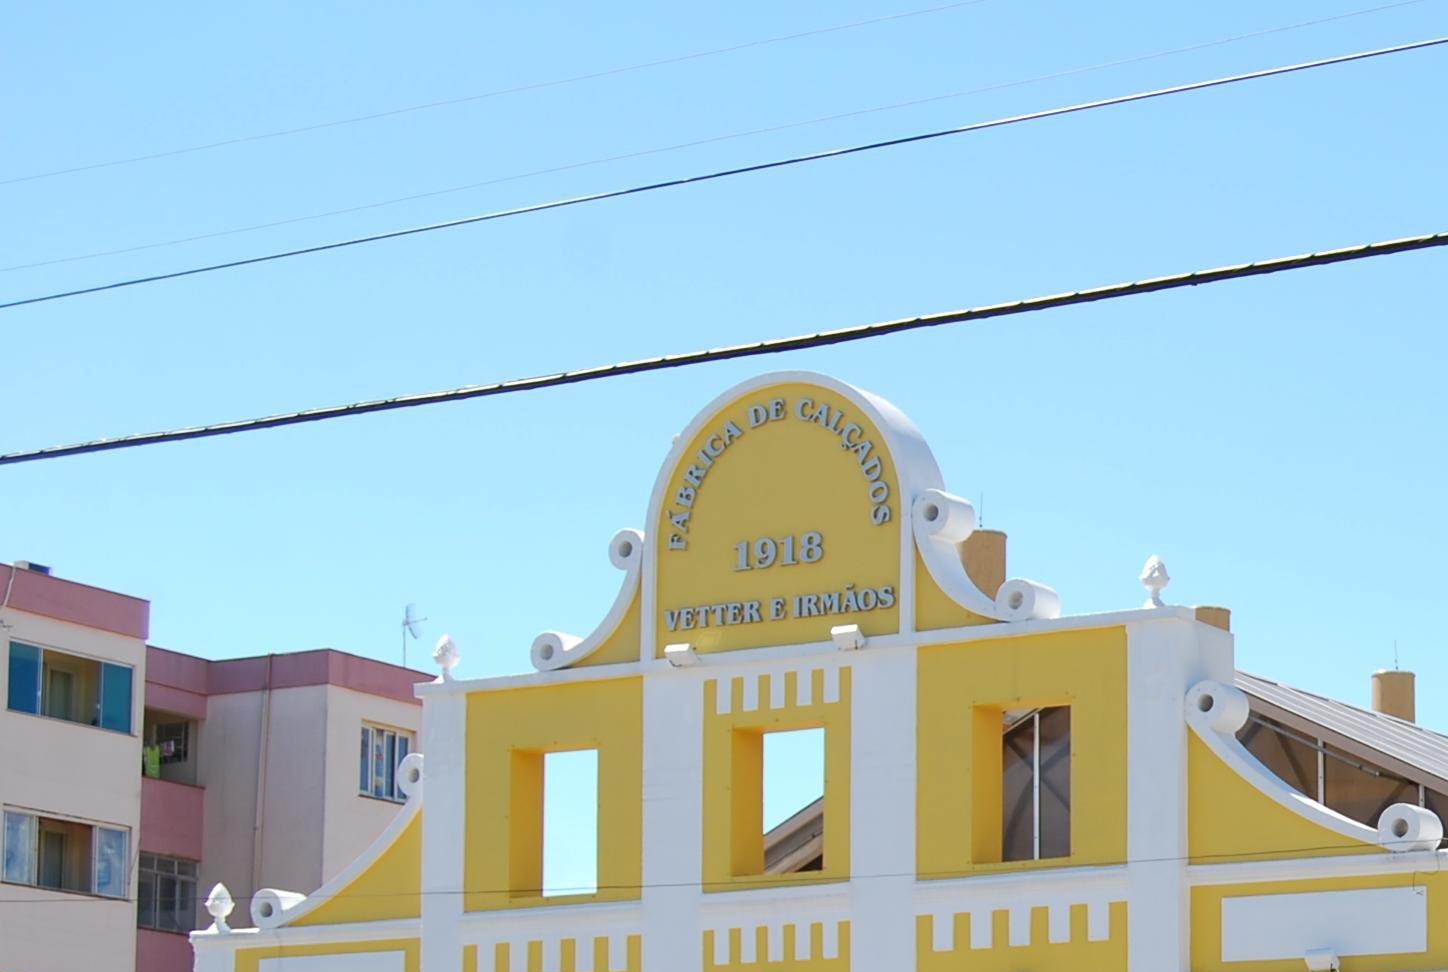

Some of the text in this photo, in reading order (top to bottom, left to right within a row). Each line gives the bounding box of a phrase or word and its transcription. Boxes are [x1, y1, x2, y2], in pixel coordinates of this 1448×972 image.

[667, 398, 891, 550] FÁBRICA DE CALÇADOS
[734, 531, 824, 572] 1918
[664, 582, 896, 631] VETTER E IRMÃOS
